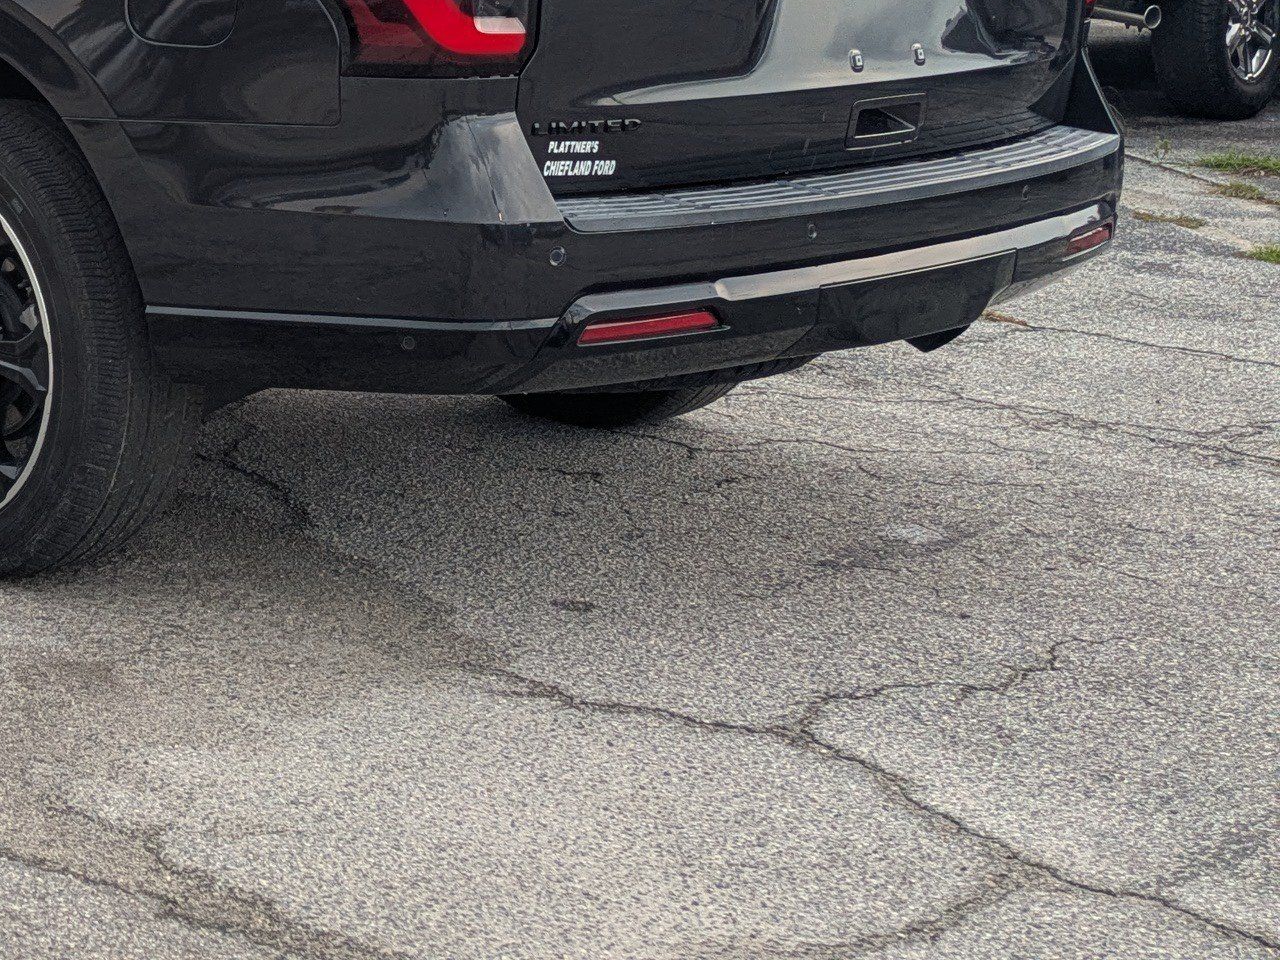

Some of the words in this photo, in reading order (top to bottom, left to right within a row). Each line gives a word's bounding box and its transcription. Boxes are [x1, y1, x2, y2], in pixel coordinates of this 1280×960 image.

[530, 119, 642, 136] LIMITED
[548, 141, 600, 154] PLATTNER'S
[543, 160, 593, 177] CHIEFLAND
[592, 160, 617, 176] FORD
